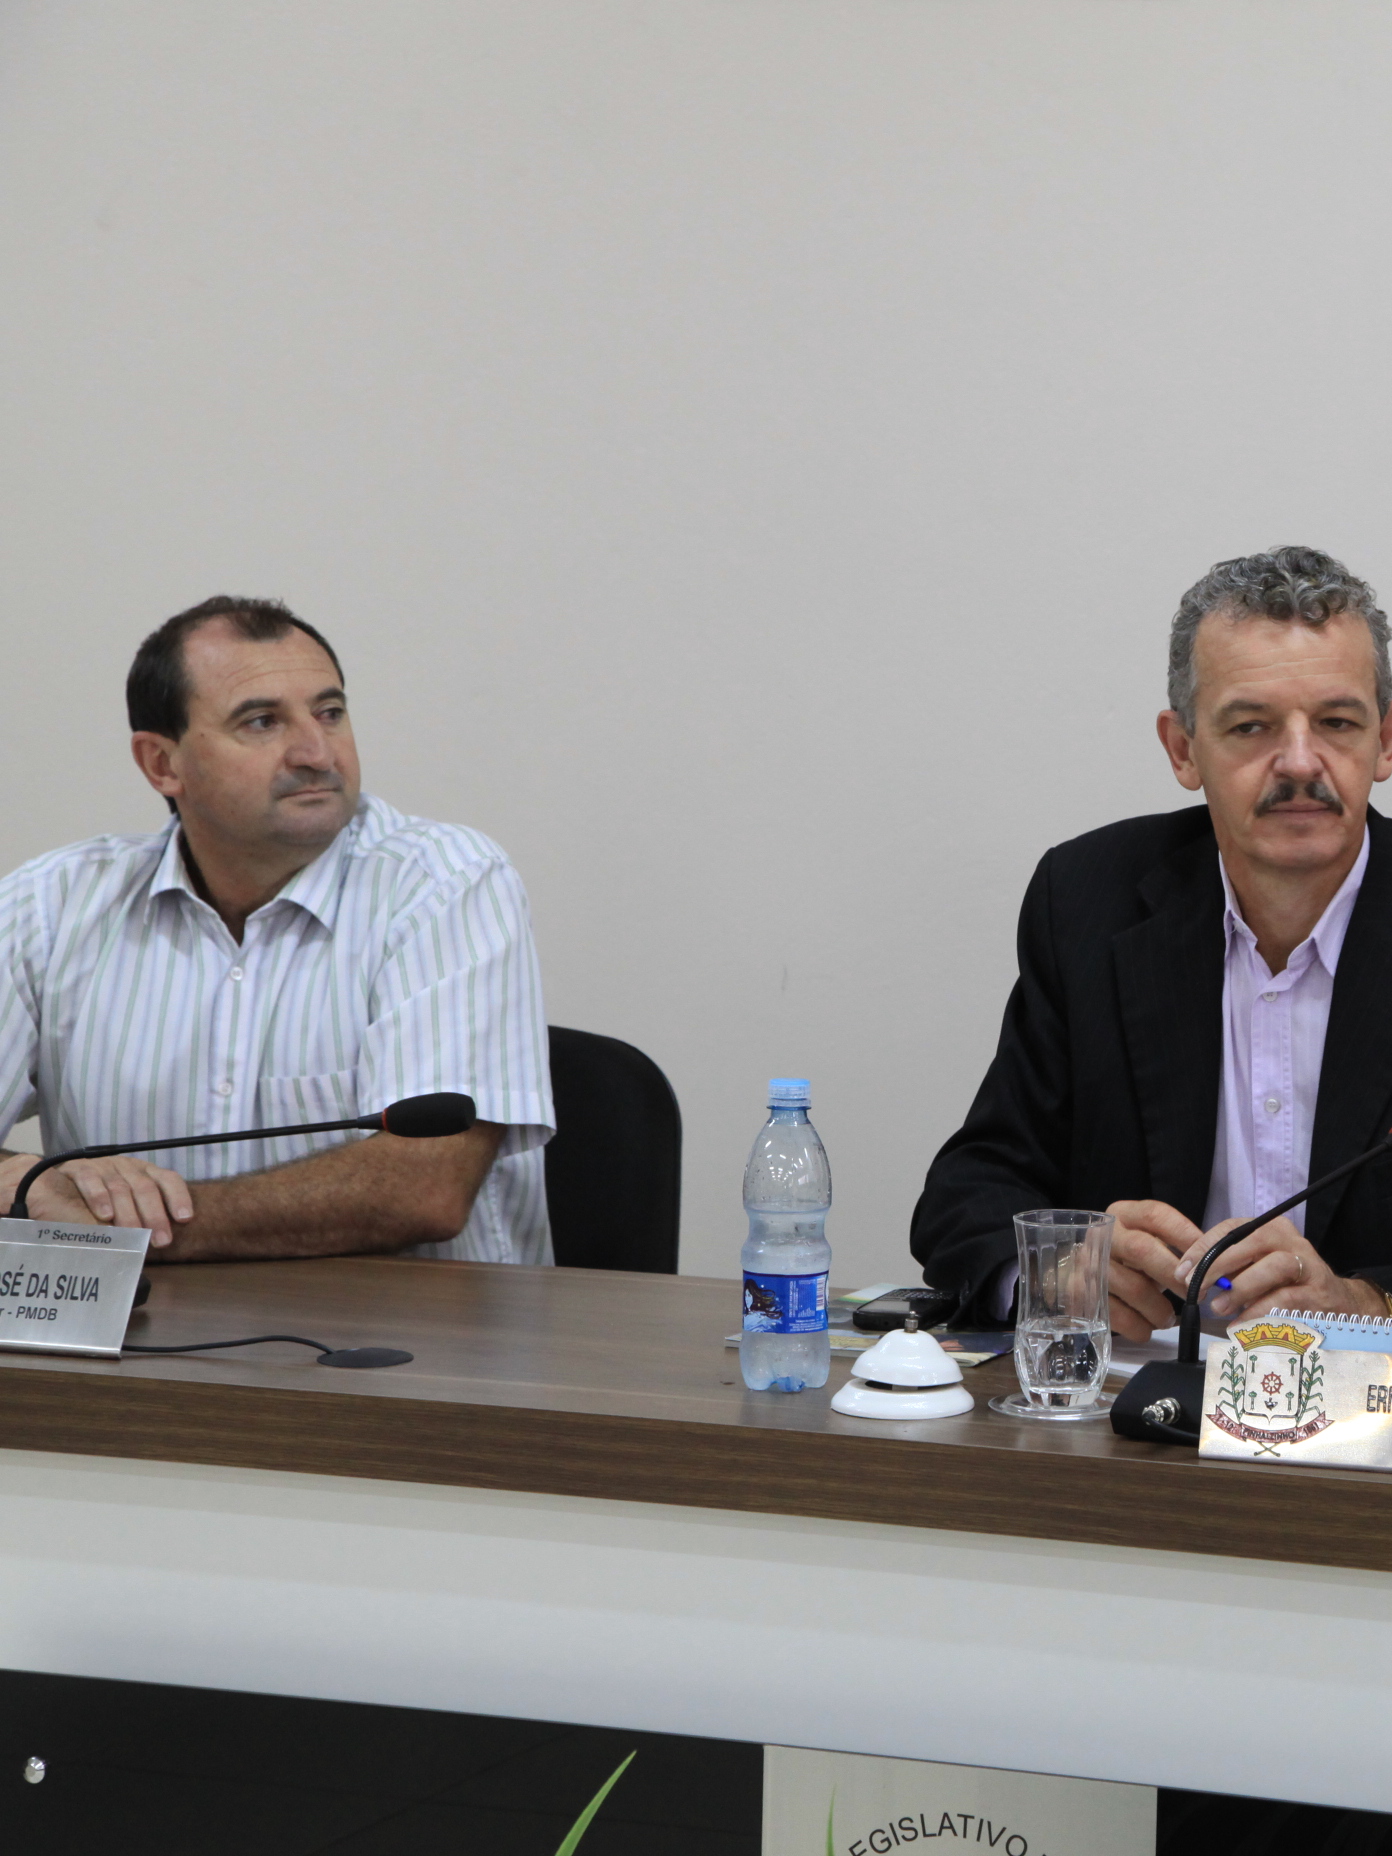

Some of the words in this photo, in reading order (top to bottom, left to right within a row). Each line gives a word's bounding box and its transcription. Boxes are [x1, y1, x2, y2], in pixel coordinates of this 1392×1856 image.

[52, 1229, 112, 1245] Secretário
[0, 1263, 24, 1297] SÉ
[25, 1273, 49, 1299] DA
[54, 1274, 100, 1302] SILVA
[15, 1305, 58, 1321] PMDB
